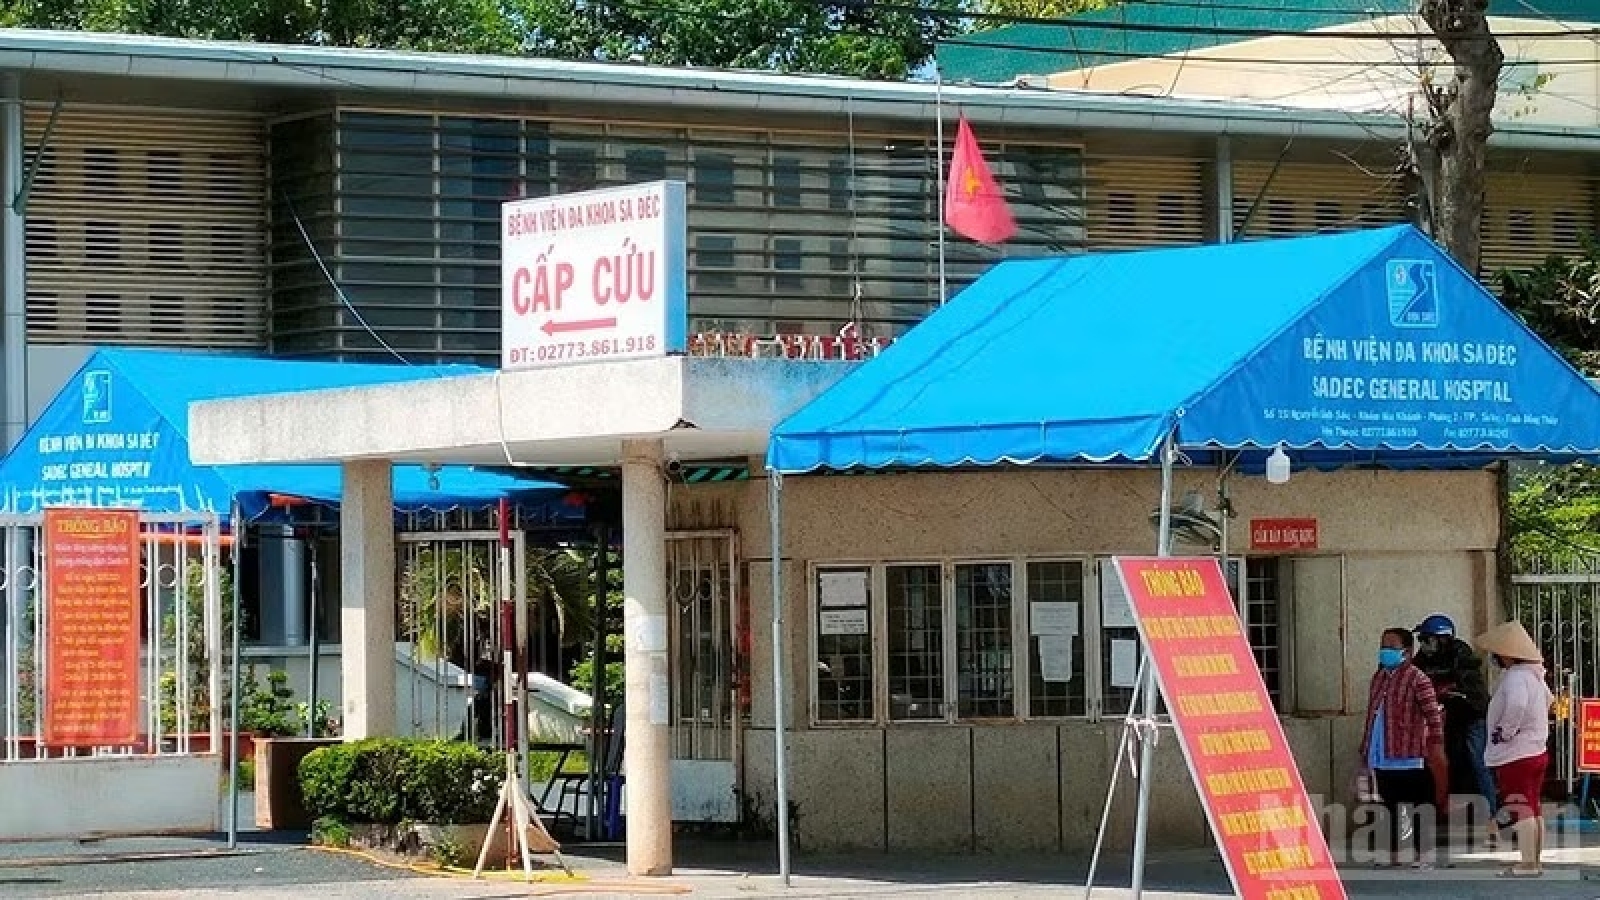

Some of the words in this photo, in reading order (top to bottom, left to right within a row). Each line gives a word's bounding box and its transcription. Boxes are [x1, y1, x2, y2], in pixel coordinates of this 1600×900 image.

[586, 201, 617, 225] KHOA
[619, 198, 633, 223] SA
[512, 243, 575, 316] CẤP
[592, 236, 655, 306] CỨU
[1303, 331, 1347, 364] BỆNH
[1352, 334, 1391, 366] VIỆN
[1421, 341, 1459, 363] KHOA
[1312, 375, 1364, 399] SADEC
[1369, 378, 1440, 401] GENERAL
[1139, 563, 1183, 597] THÔNG
[1177, 563, 1206, 597] BÁO
